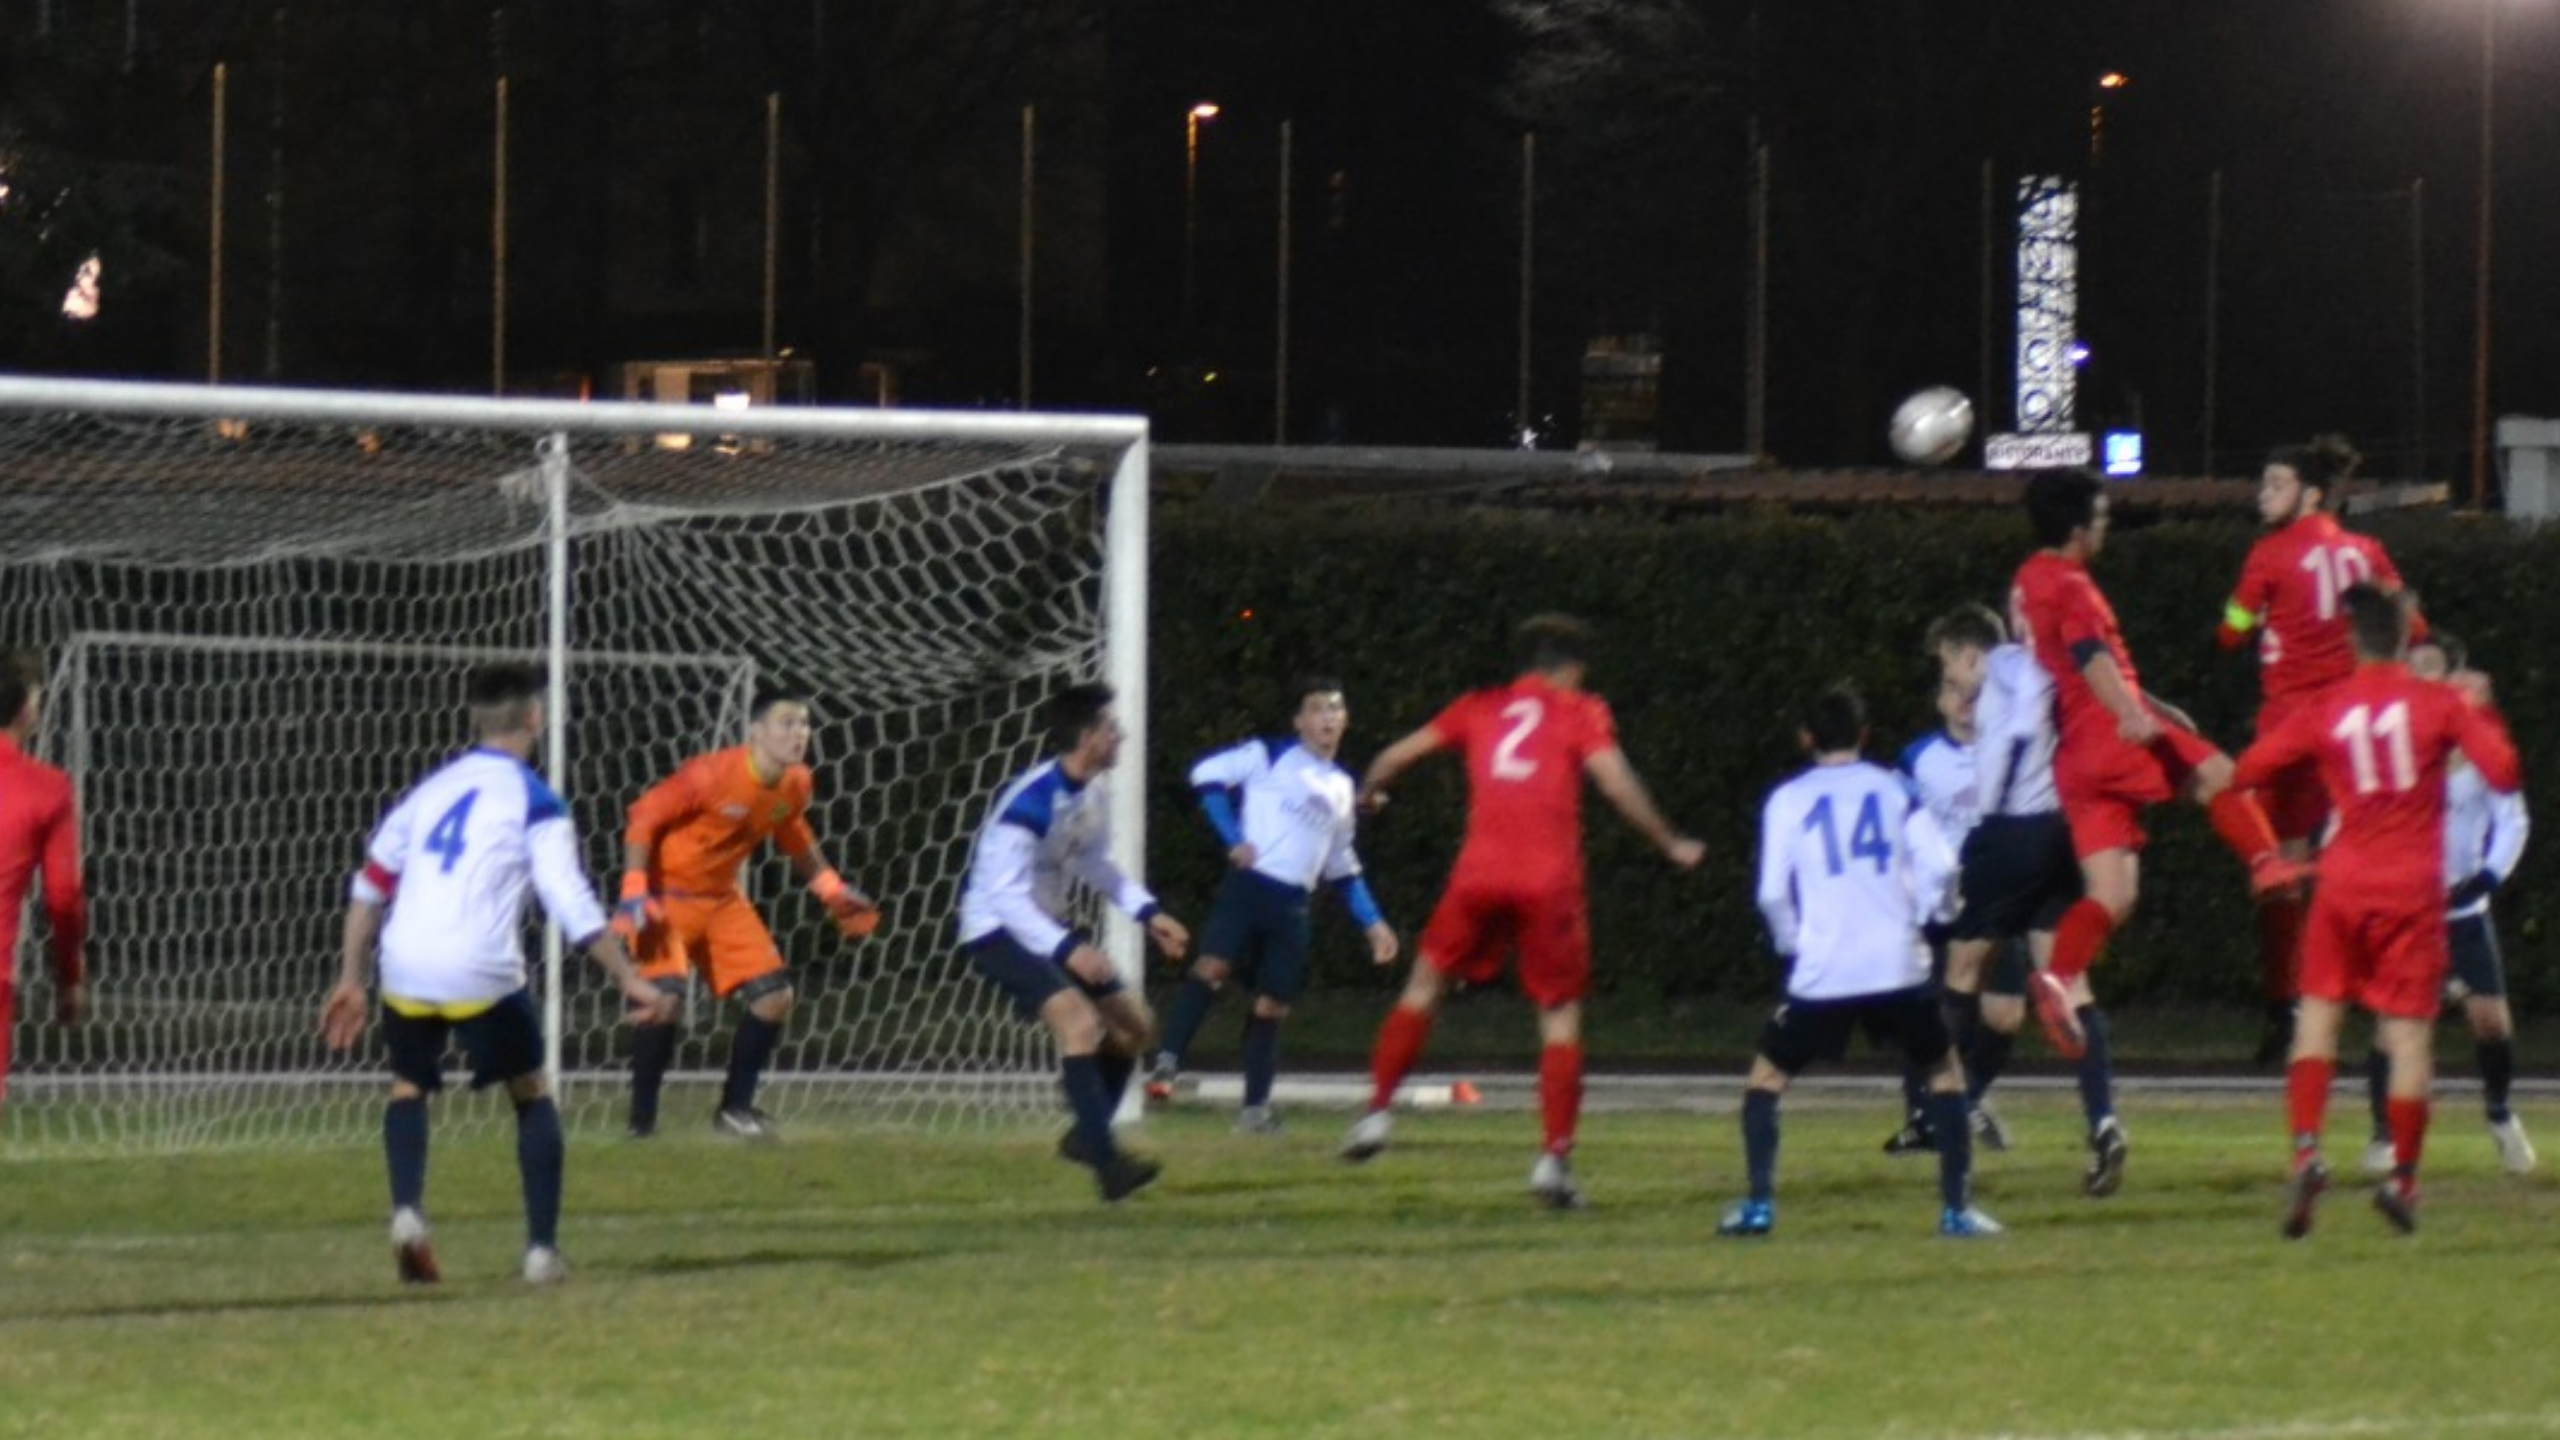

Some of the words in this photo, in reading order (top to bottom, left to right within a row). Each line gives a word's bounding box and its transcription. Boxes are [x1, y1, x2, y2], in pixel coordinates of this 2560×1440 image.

[1491, 698, 1543, 780] 2
[2333, 700, 2418, 794] 11
[425, 787, 480, 874] 4
[1804, 793, 1892, 876] 14
